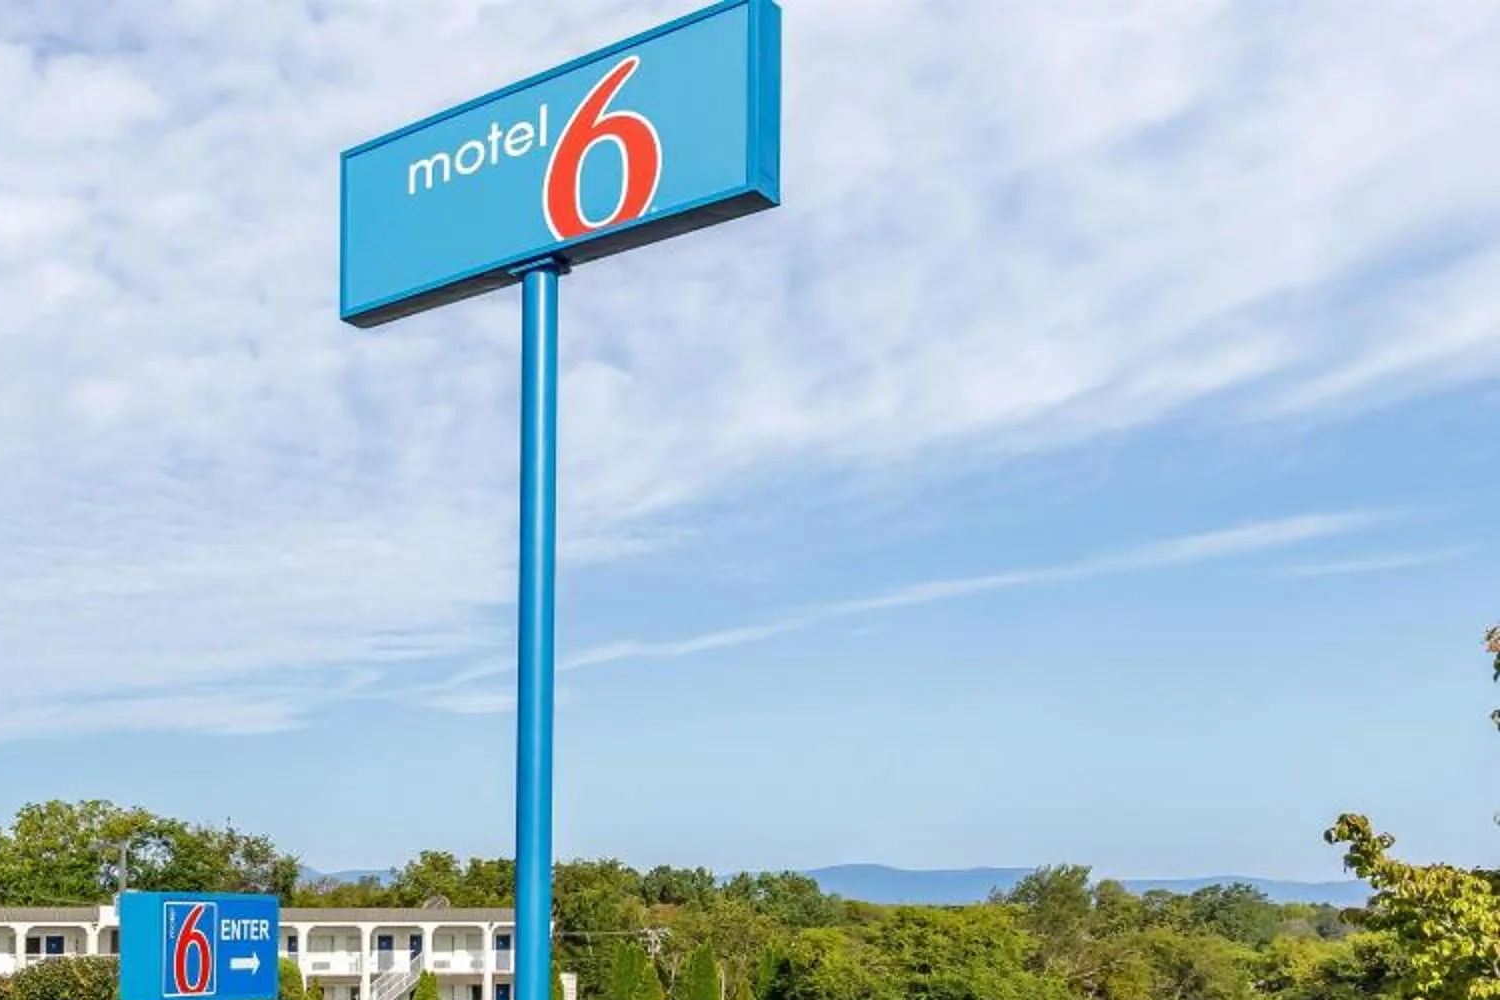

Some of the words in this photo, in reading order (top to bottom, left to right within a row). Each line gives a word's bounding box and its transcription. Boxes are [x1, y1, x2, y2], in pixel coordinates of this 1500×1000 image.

[408, 103, 548, 196] motel
[542, 55, 663, 242] 6
[174, 904, 211, 994] 6
[221, 919, 270, 940] ENTER
